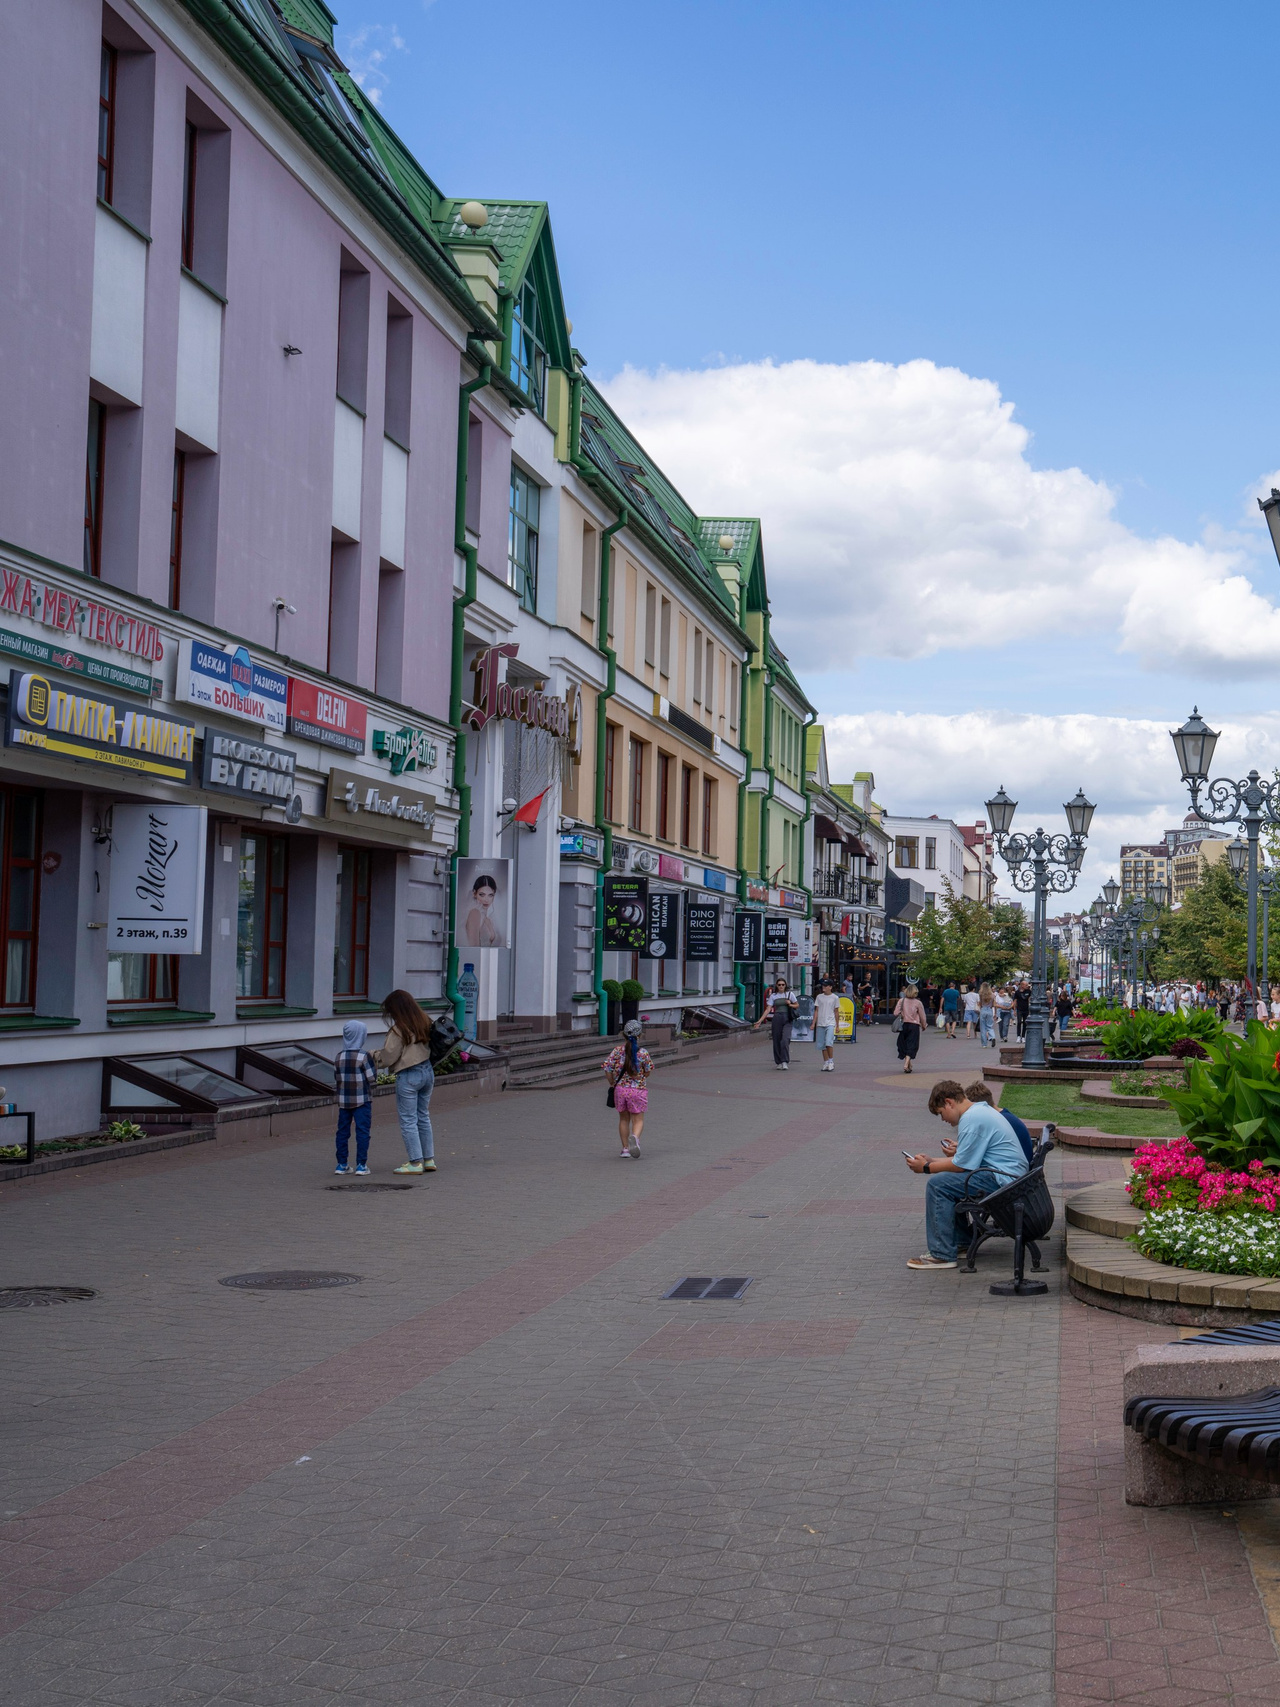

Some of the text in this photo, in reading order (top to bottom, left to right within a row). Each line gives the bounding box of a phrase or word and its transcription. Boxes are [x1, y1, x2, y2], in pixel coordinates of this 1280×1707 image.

[1, 569, 164, 662] ЖА МЕХ ТЕКСТИЛЬ
[22, 642, 49, 659] МАГАЗИН
[87, 662, 102, 675] ЦЕНЫ
[103, 666, 110, 677] ОТ
[110, 668, 149, 691] ПРОИЗВОДИТЕЛЯ
[197, 652, 286, 696] ОДЕЖДА РАЗМЕРОВ
[214, 687, 266, 720] БОЛЬШИХ
[317, 691, 348, 729] DELFIN
[114, 755, 140, 768] ПАВИЛЬОН
[210, 757, 295, 800] BY FAMA
[136, 812, 179, 912] Mozart
[651, 895, 661, 940] PELICAN
[661, 895, 669, 928] ПЕЛИКАН
[690, 909, 715, 919] DINO
[690, 920, 715, 929] RICCI
[767, 922, 787, 930] ВЕЙП
[116, 927, 188, 940] 2 этаж, п.39
[742, 917, 751, 957] medicine
